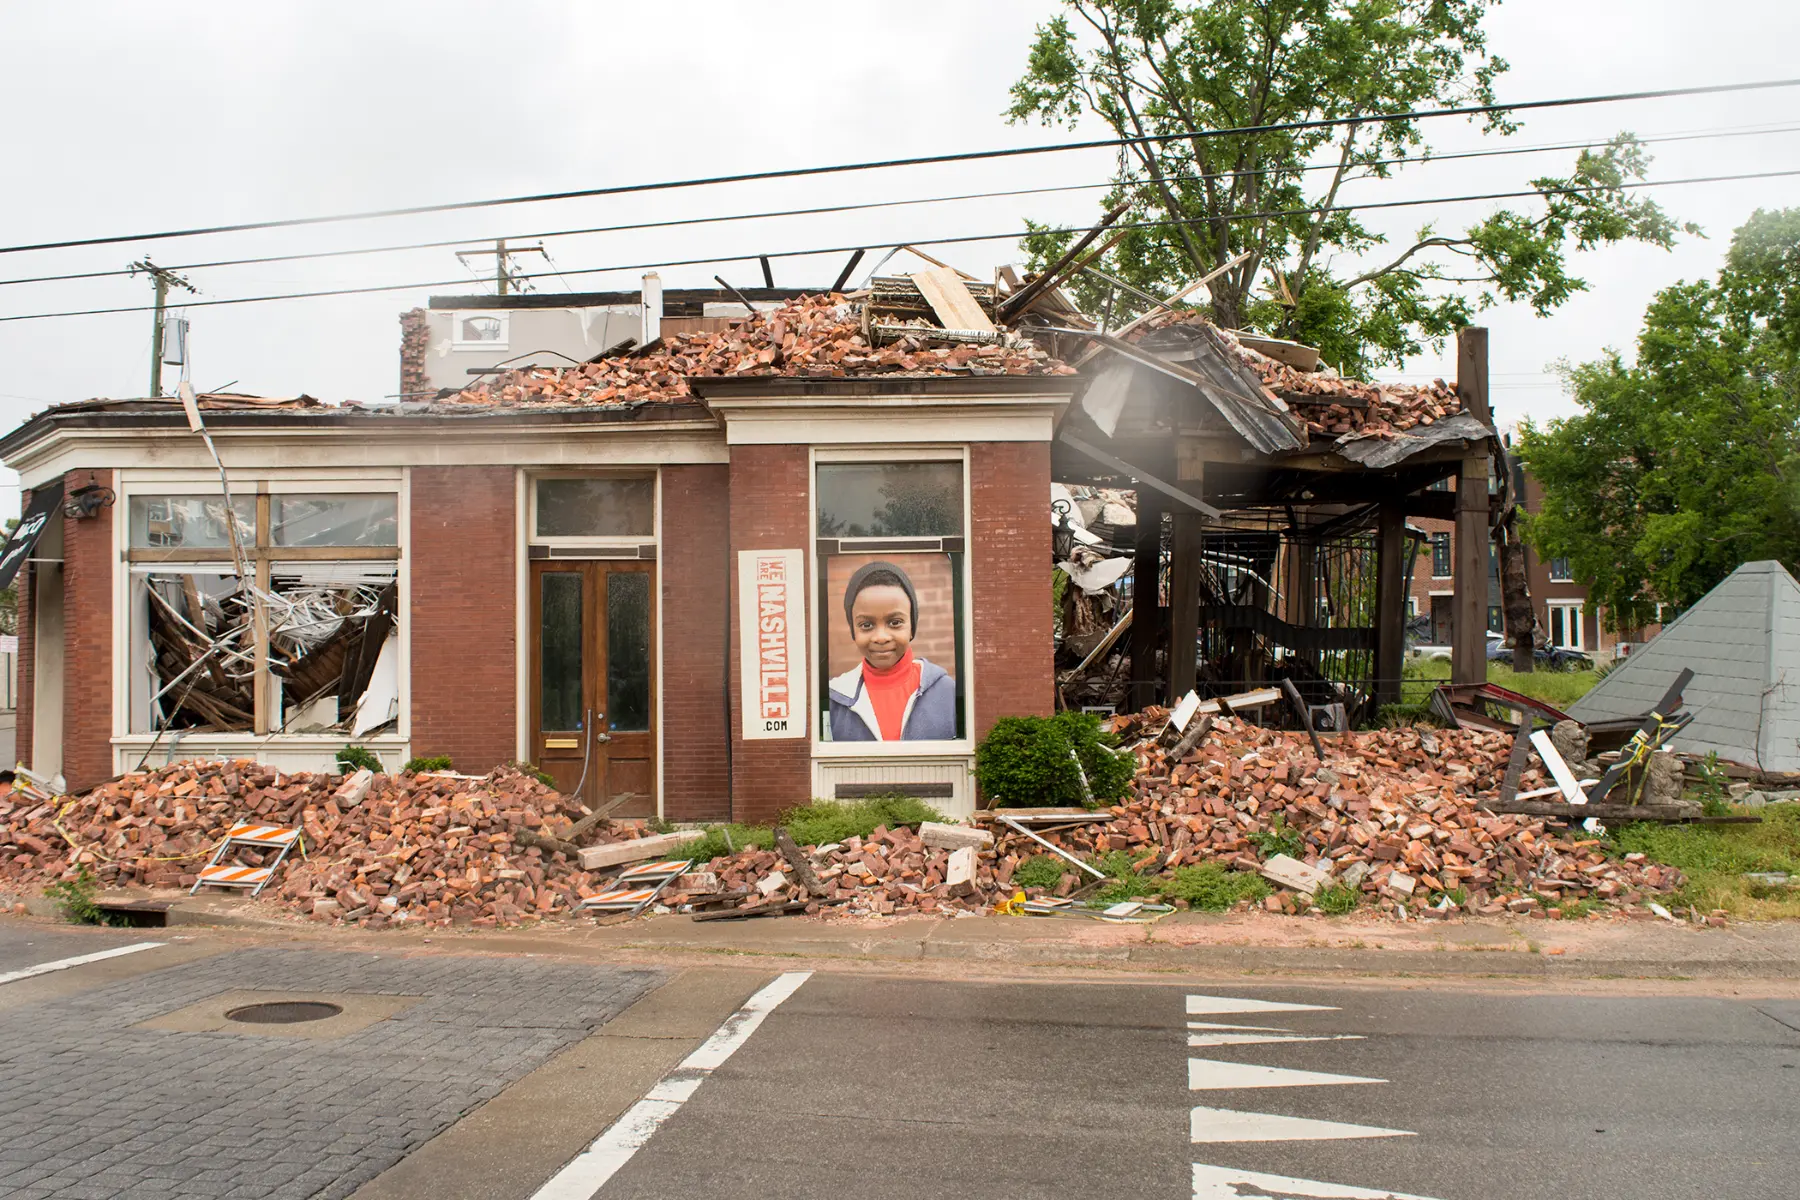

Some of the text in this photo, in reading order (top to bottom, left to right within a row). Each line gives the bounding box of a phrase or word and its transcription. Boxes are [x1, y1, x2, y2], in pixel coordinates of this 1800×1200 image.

[759, 561, 769, 581] ARE
[768, 560, 784, 581] WE
[759, 584, 788, 718] NASHVILLE
[763, 720, 788, 731] .COM
